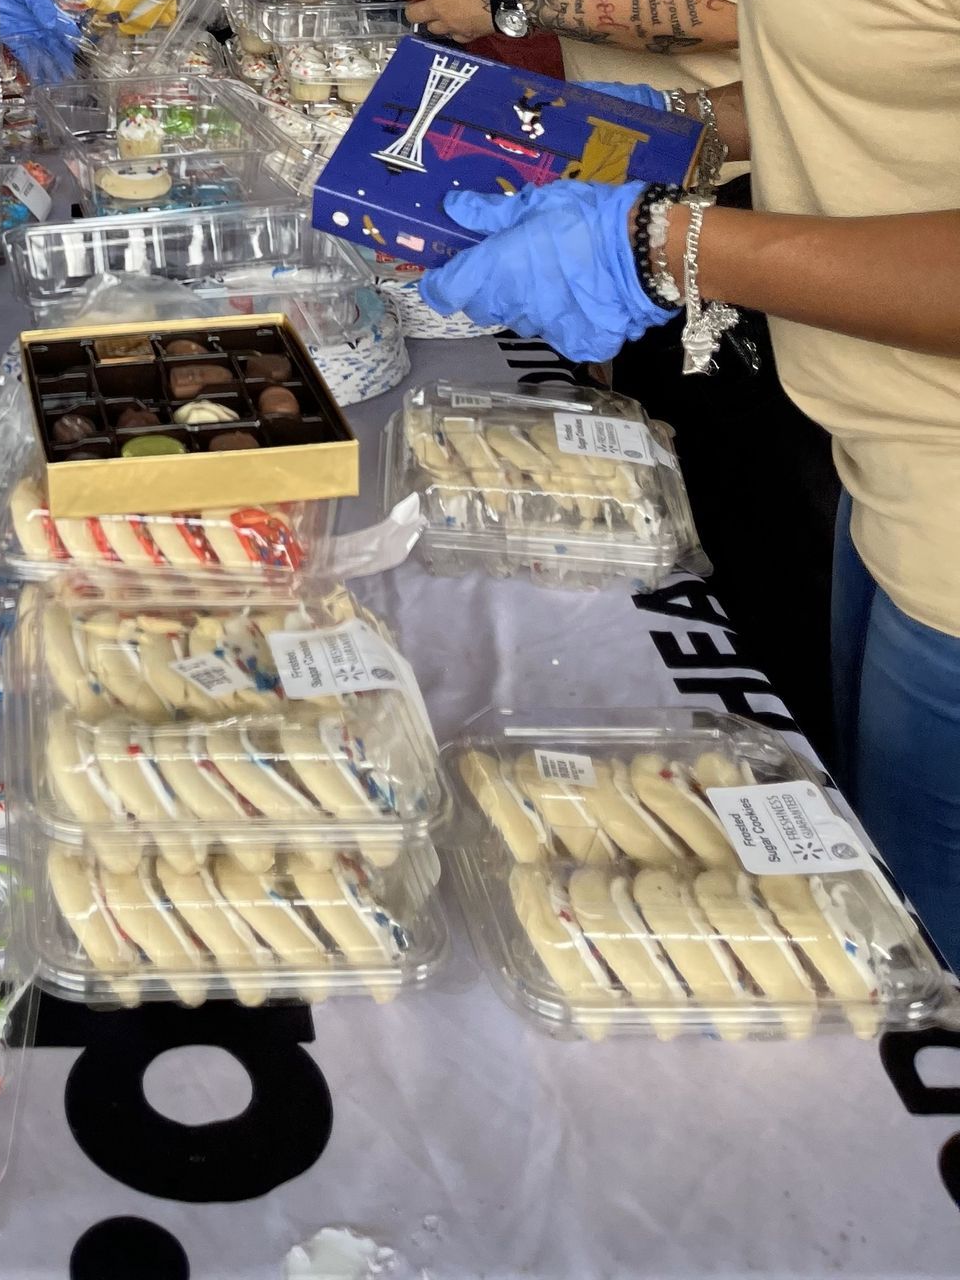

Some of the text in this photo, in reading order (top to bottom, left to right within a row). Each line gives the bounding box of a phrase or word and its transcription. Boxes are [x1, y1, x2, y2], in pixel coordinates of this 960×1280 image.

[728, 812, 756, 848] Frosted
[740, 797, 781, 864] Sugar Cookies
[766, 794, 800, 841] FRESHNESS
